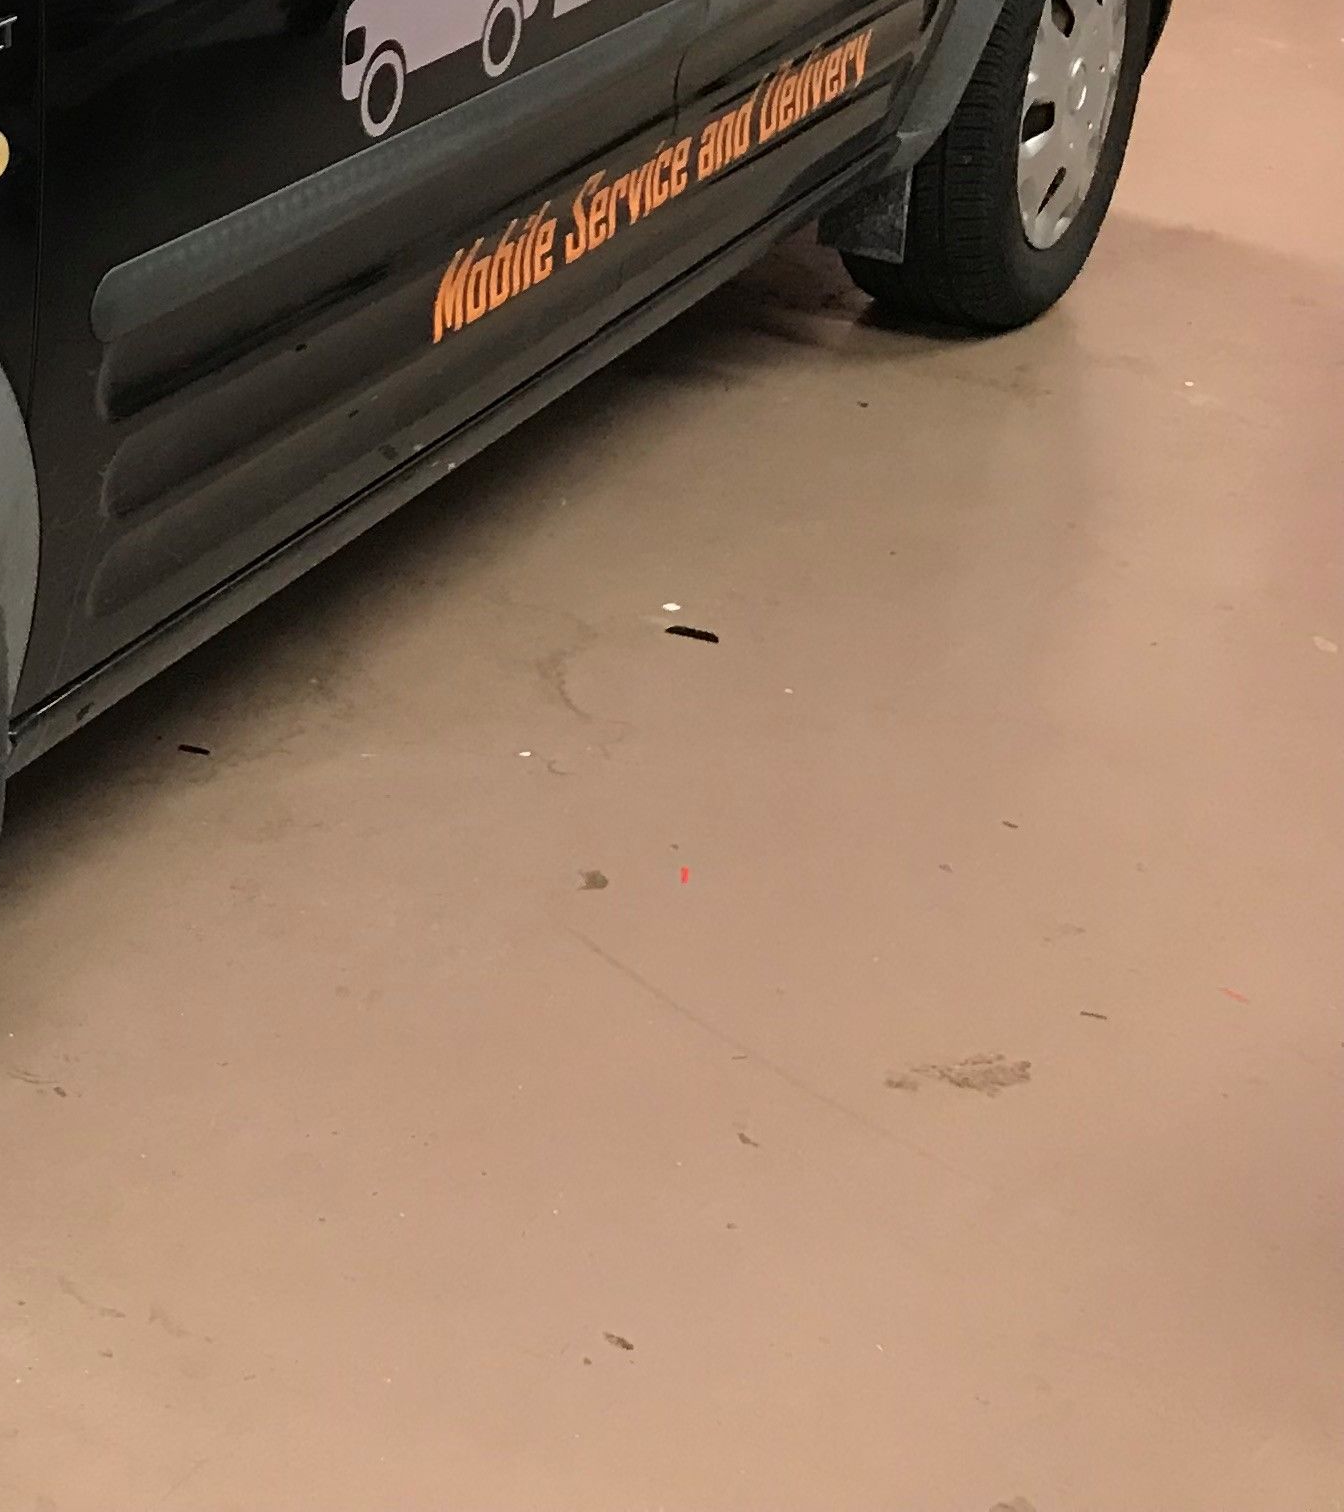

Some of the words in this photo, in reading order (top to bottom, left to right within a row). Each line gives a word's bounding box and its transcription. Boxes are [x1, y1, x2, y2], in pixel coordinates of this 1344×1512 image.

[432, 200, 559, 344] Mobile
[564, 170, 694, 265] Service
[698, 85, 762, 182] and
